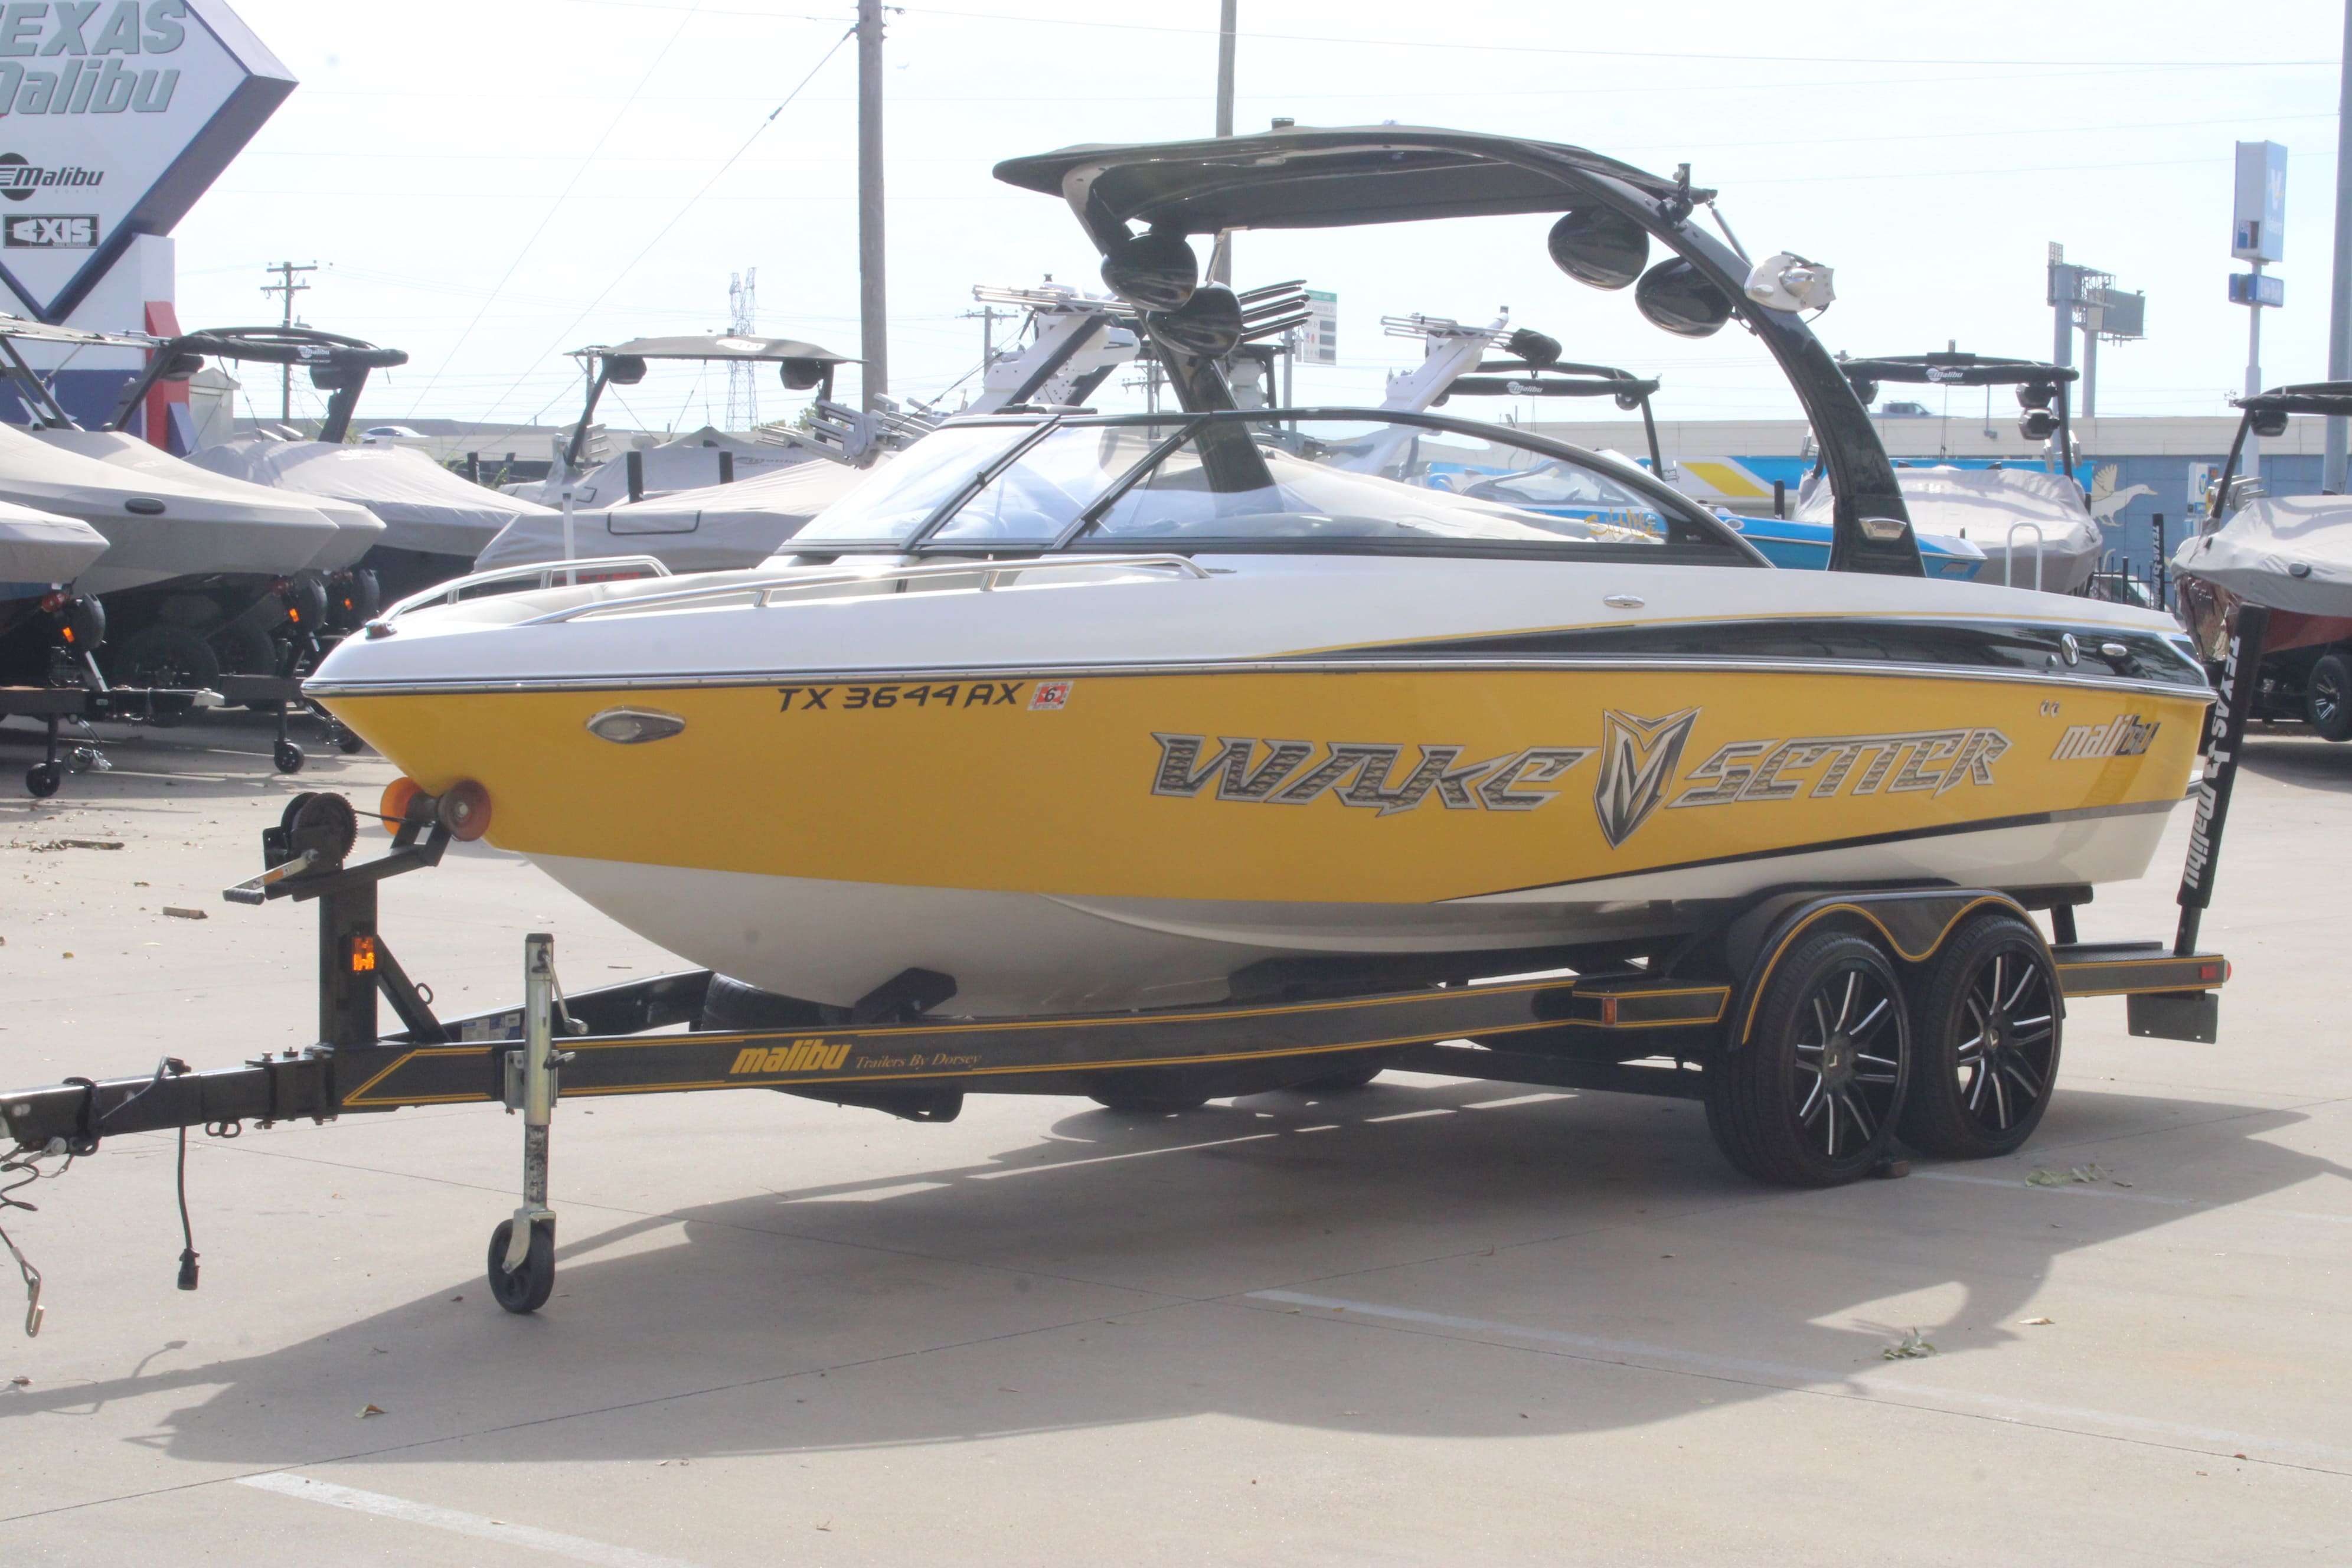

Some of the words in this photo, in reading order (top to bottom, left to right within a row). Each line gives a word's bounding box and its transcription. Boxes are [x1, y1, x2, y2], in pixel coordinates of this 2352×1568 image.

[0, 0, 187, 56] EXAS
[14, 219, 91, 243] AXIS
[778, 687, 834, 713] TX
[842, 685, 961, 710] 3644
[963, 682, 1025, 708] AX
[2211, 636, 2241, 739] TEXAS
[2049, 714, 2161, 760] malibu
[729, 1039, 852, 1074] malibu
[857, 1056, 906, 1069] Trailers
[909, 1054, 926, 1070] By
[931, 1053, 982, 1068] Dorsey
